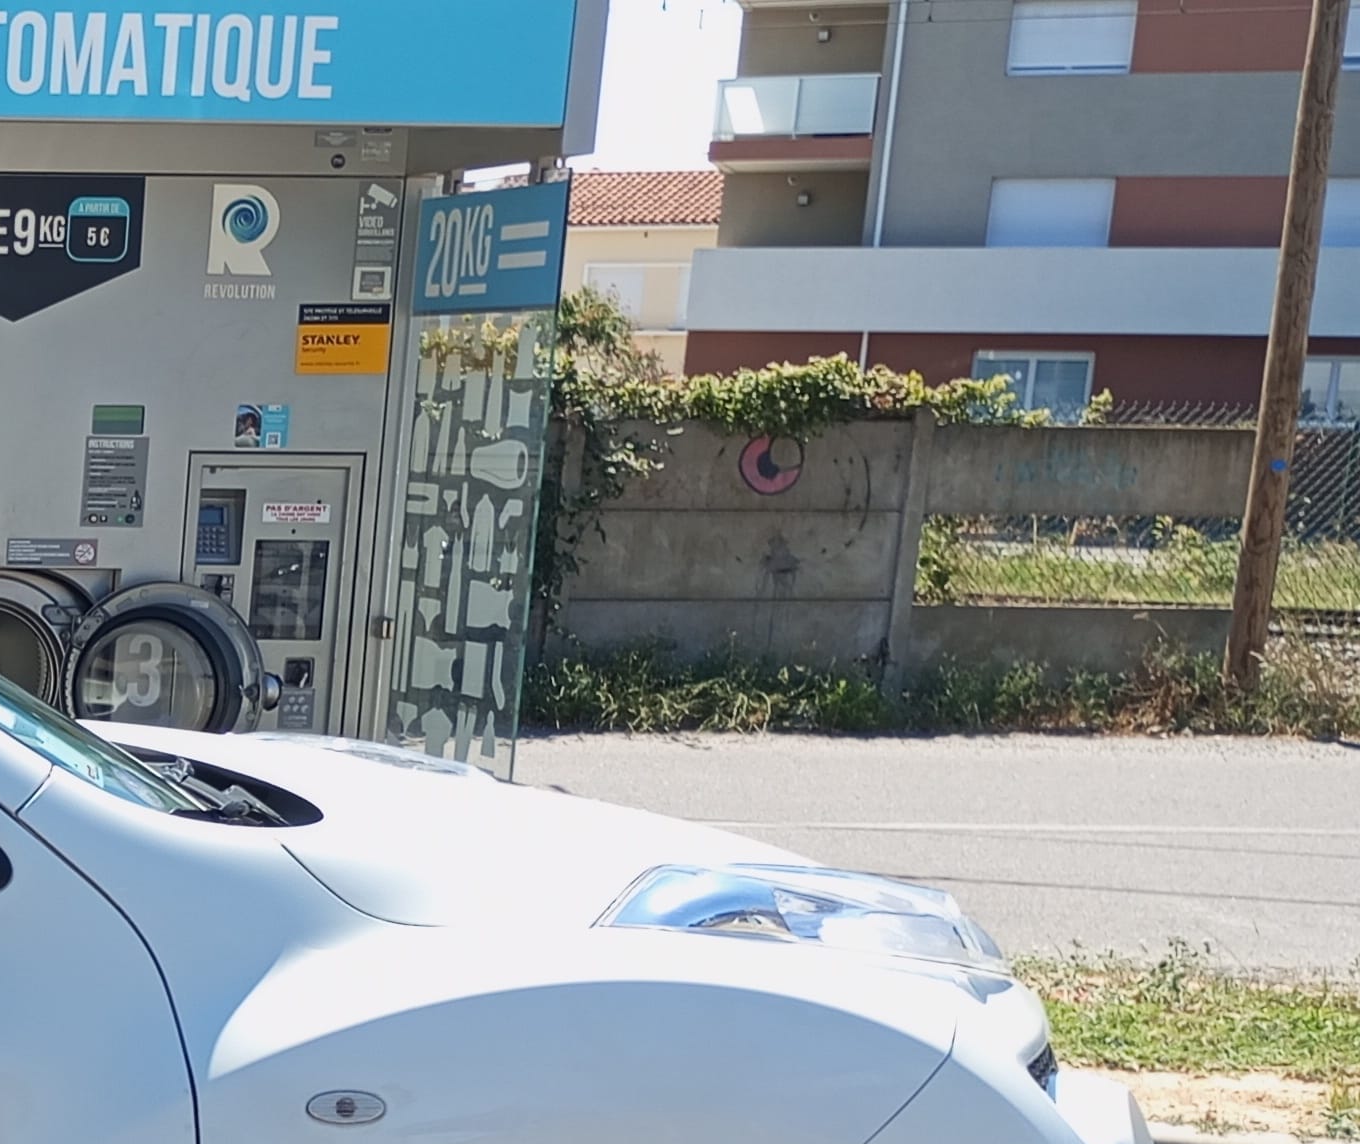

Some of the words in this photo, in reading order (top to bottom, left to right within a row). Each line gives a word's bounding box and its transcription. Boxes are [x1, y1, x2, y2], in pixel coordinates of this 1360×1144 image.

[13, 208, 36, 256] 9
[38, 215, 66, 243] KG
[425, 203, 494, 298] 20KG
[203, 283, 276, 299] REVOLUTION
